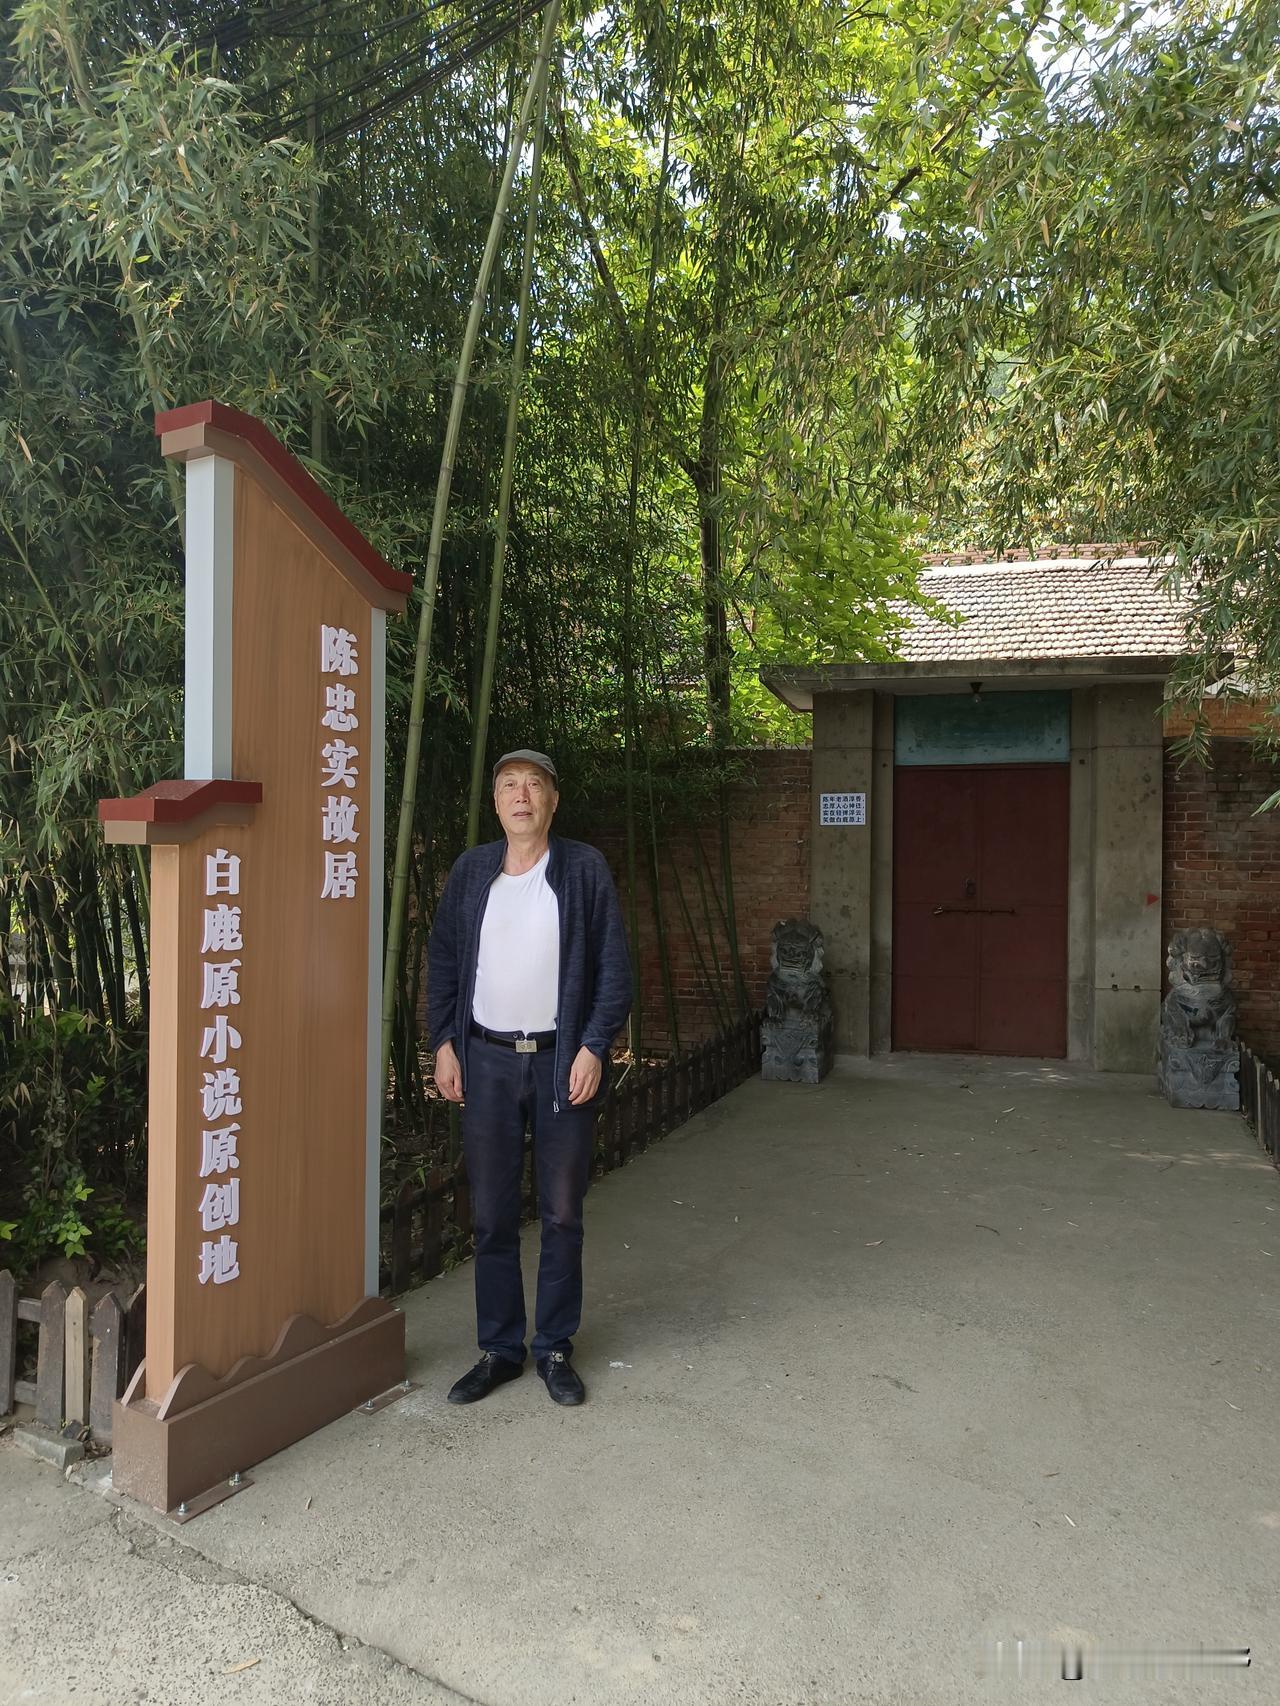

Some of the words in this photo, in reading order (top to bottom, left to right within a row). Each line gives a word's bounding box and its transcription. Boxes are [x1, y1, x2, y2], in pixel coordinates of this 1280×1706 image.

[320, 623, 360, 900] 陈忠实故居
[198, 848, 242, 1285] 白鹿原小说原创地
